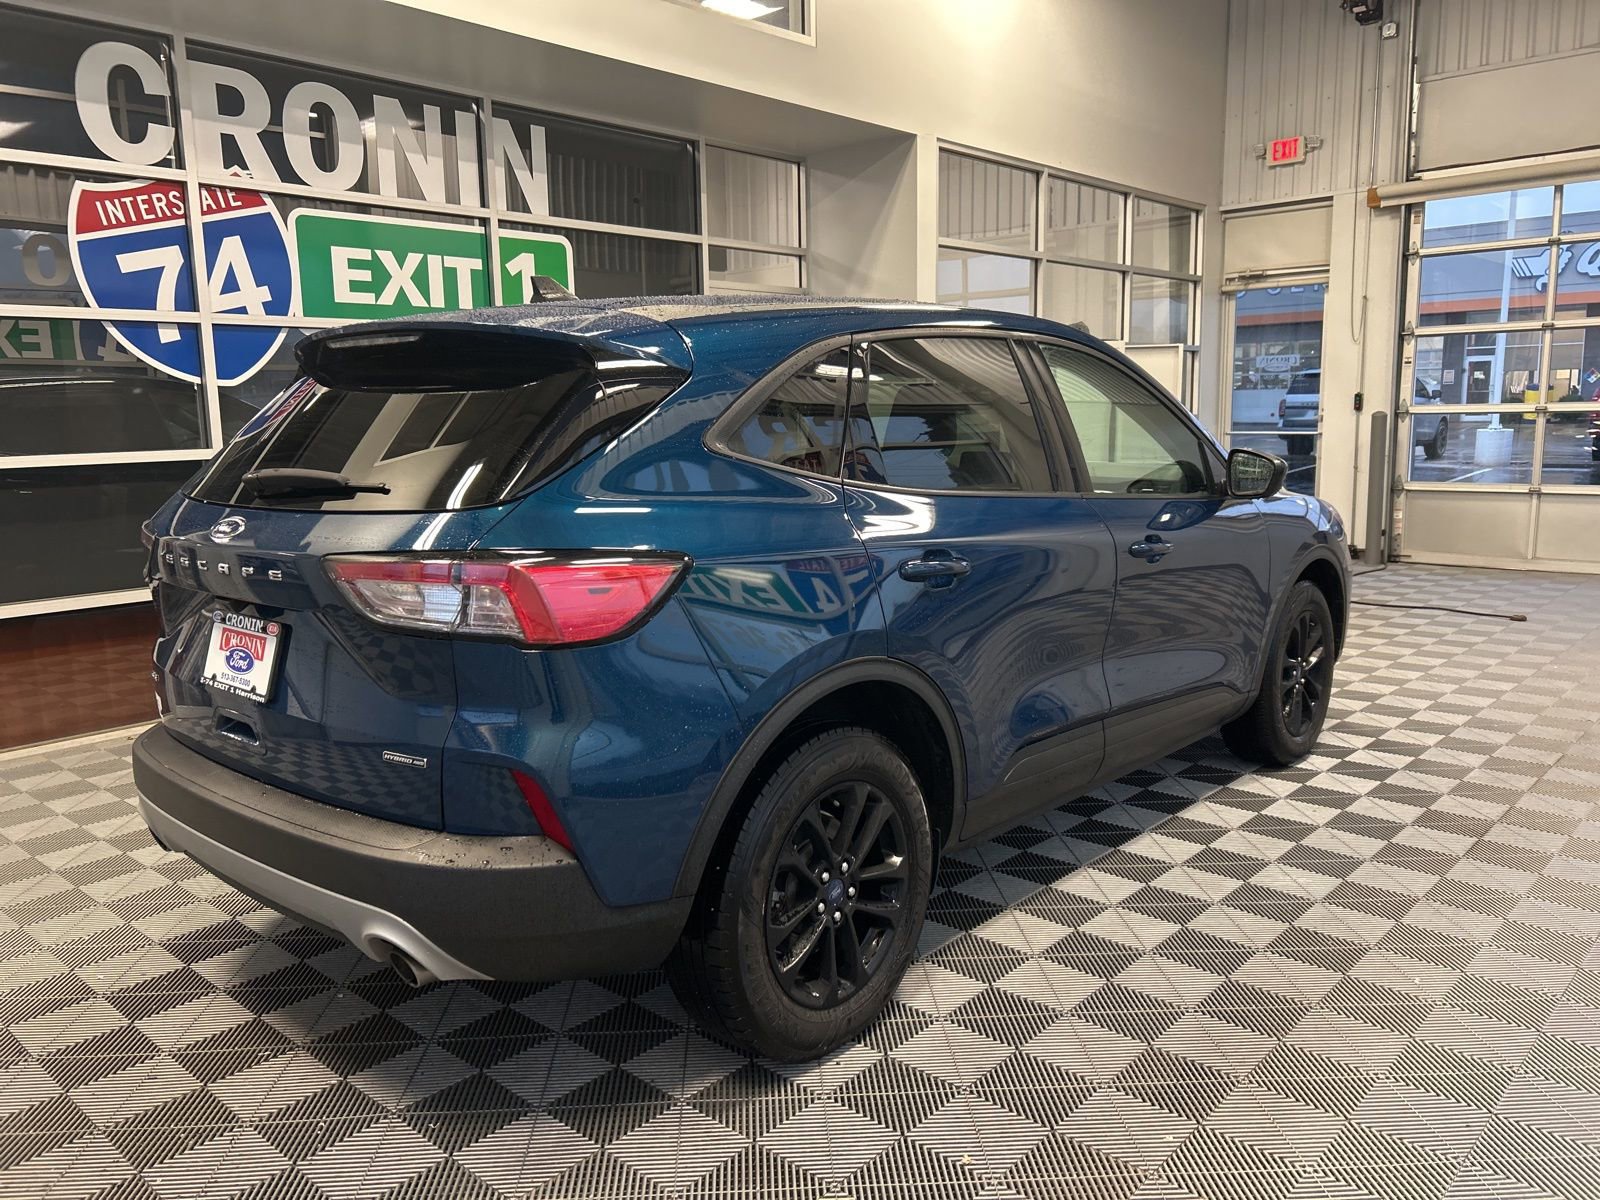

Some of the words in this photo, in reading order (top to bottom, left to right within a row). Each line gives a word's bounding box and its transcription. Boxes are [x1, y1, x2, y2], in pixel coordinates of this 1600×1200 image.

[75, 41, 549, 216] CRONIN
[1272, 137, 1299, 162] EXIT
[95, 187, 243, 226] INTERSATE
[116, 235, 272, 344] 74
[330, 244, 483, 310] EXIT
[505, 252, 536, 305] 1
[226, 613, 263, 633] CRONIN
[222, 631, 264, 659] CRONIN
[230, 650, 250, 669] Ford
[214, 682, 229, 691] EXIT
[235, 688, 264, 703] Harrison
